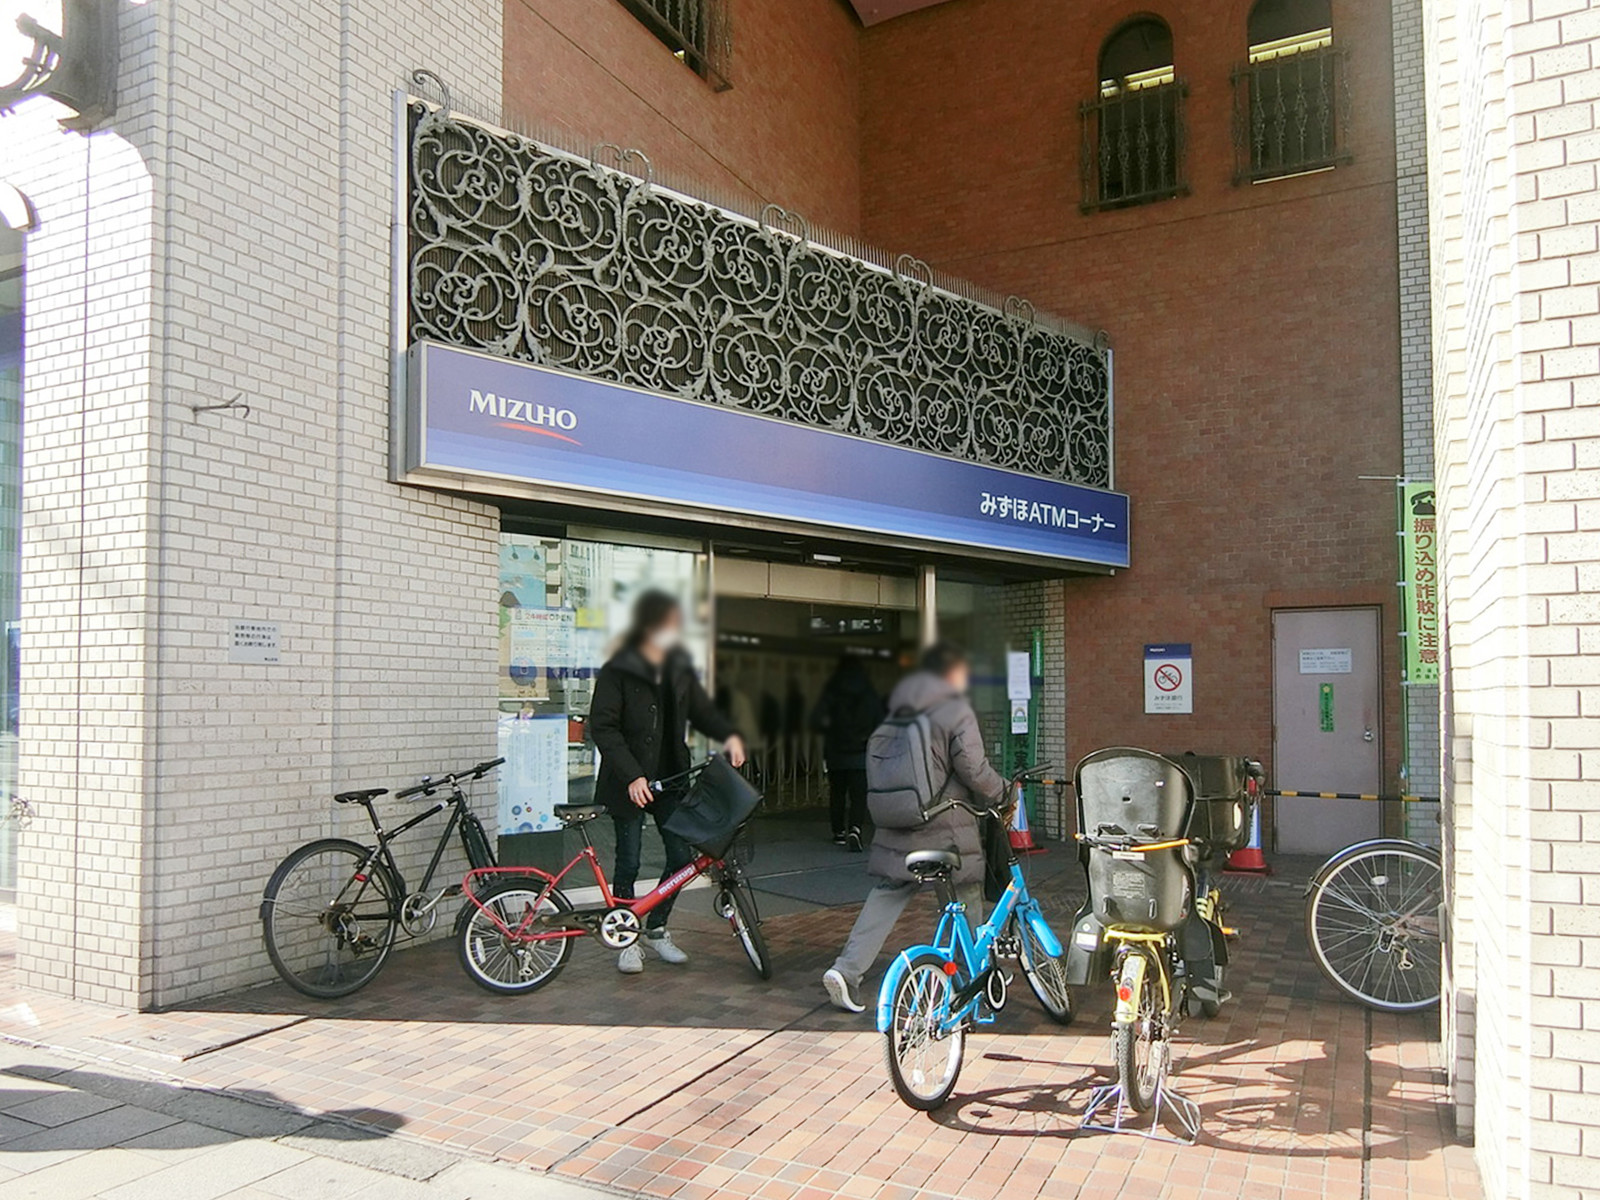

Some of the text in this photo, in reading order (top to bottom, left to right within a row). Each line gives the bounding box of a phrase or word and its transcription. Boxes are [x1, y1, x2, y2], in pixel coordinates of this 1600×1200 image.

[468, 389, 578, 431] MIZUHO
[980, 492, 1116, 533] みずほATMコーナー
[1413, 518, 1438, 664] 振り込め詐欺に注意
